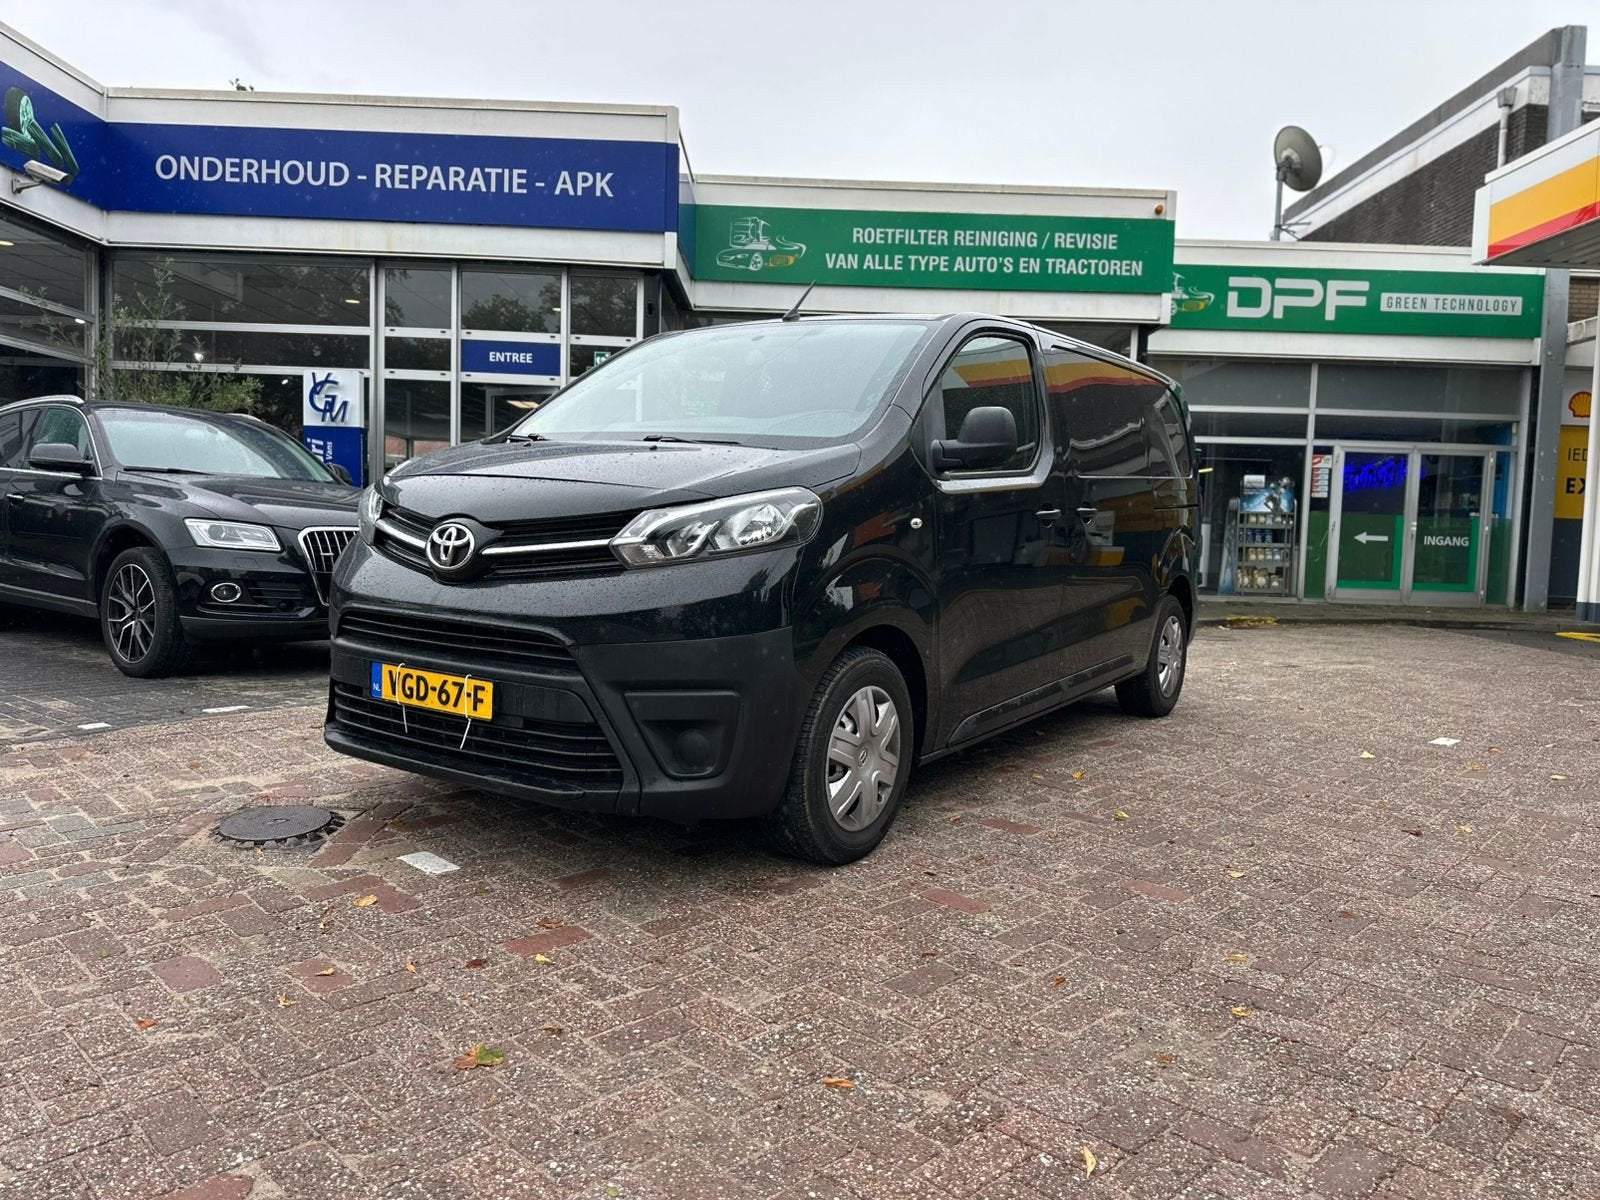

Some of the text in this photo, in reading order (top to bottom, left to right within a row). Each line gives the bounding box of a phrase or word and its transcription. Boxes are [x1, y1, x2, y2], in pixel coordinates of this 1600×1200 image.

[155, 154, 350, 187] ONDERHOUD
[375, 163, 528, 194] REPARATIE
[554, 170, 614, 198] APK
[852, 227, 1118, 250] ROETFILTER REINIGING / REVISIE
[825, 253, 1143, 276] VAN ALLE TYPE AUTO'S EN TRACTOREN
[1226, 276, 1370, 321] DPF
[1386, 296, 1518, 313] GREEN TECHNOLOGY
[489, 351, 533, 363] ENTREE
[1423, 535, 1470, 547] INGANG
[372, 682, 381, 691] NL
[388, 669, 486, 712] VGD-67-F
